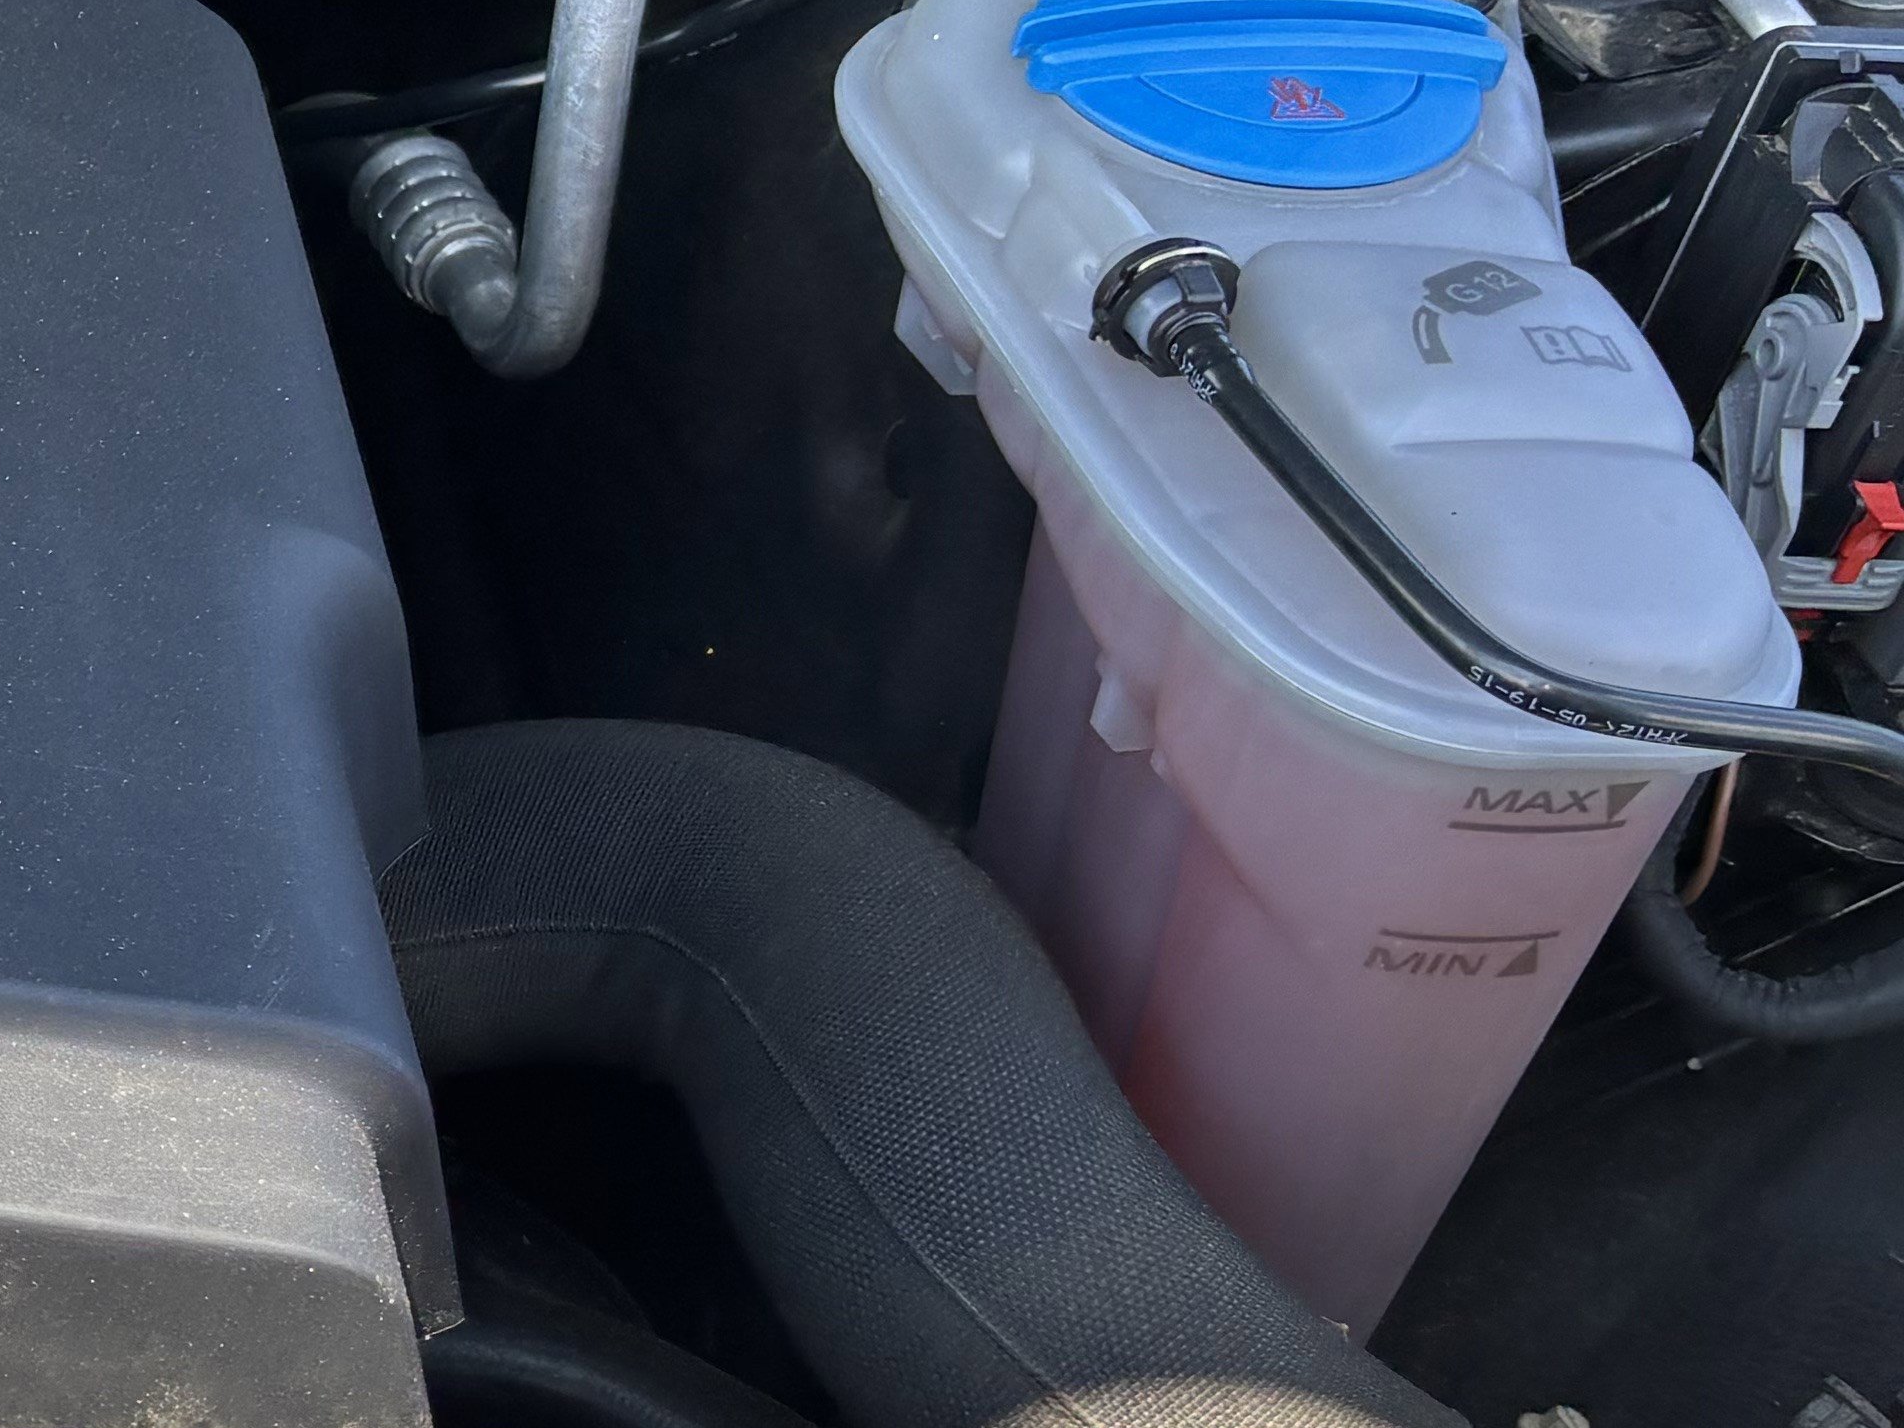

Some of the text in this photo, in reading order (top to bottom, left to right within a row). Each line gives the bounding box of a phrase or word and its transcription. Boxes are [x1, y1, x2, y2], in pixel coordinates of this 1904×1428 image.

[1446, 270, 1514, 308] G12
[1467, 665, 1587, 726] 05-19-15
[1465, 786, 1599, 816] MAX
[1363, 942, 1490, 978] MIN
